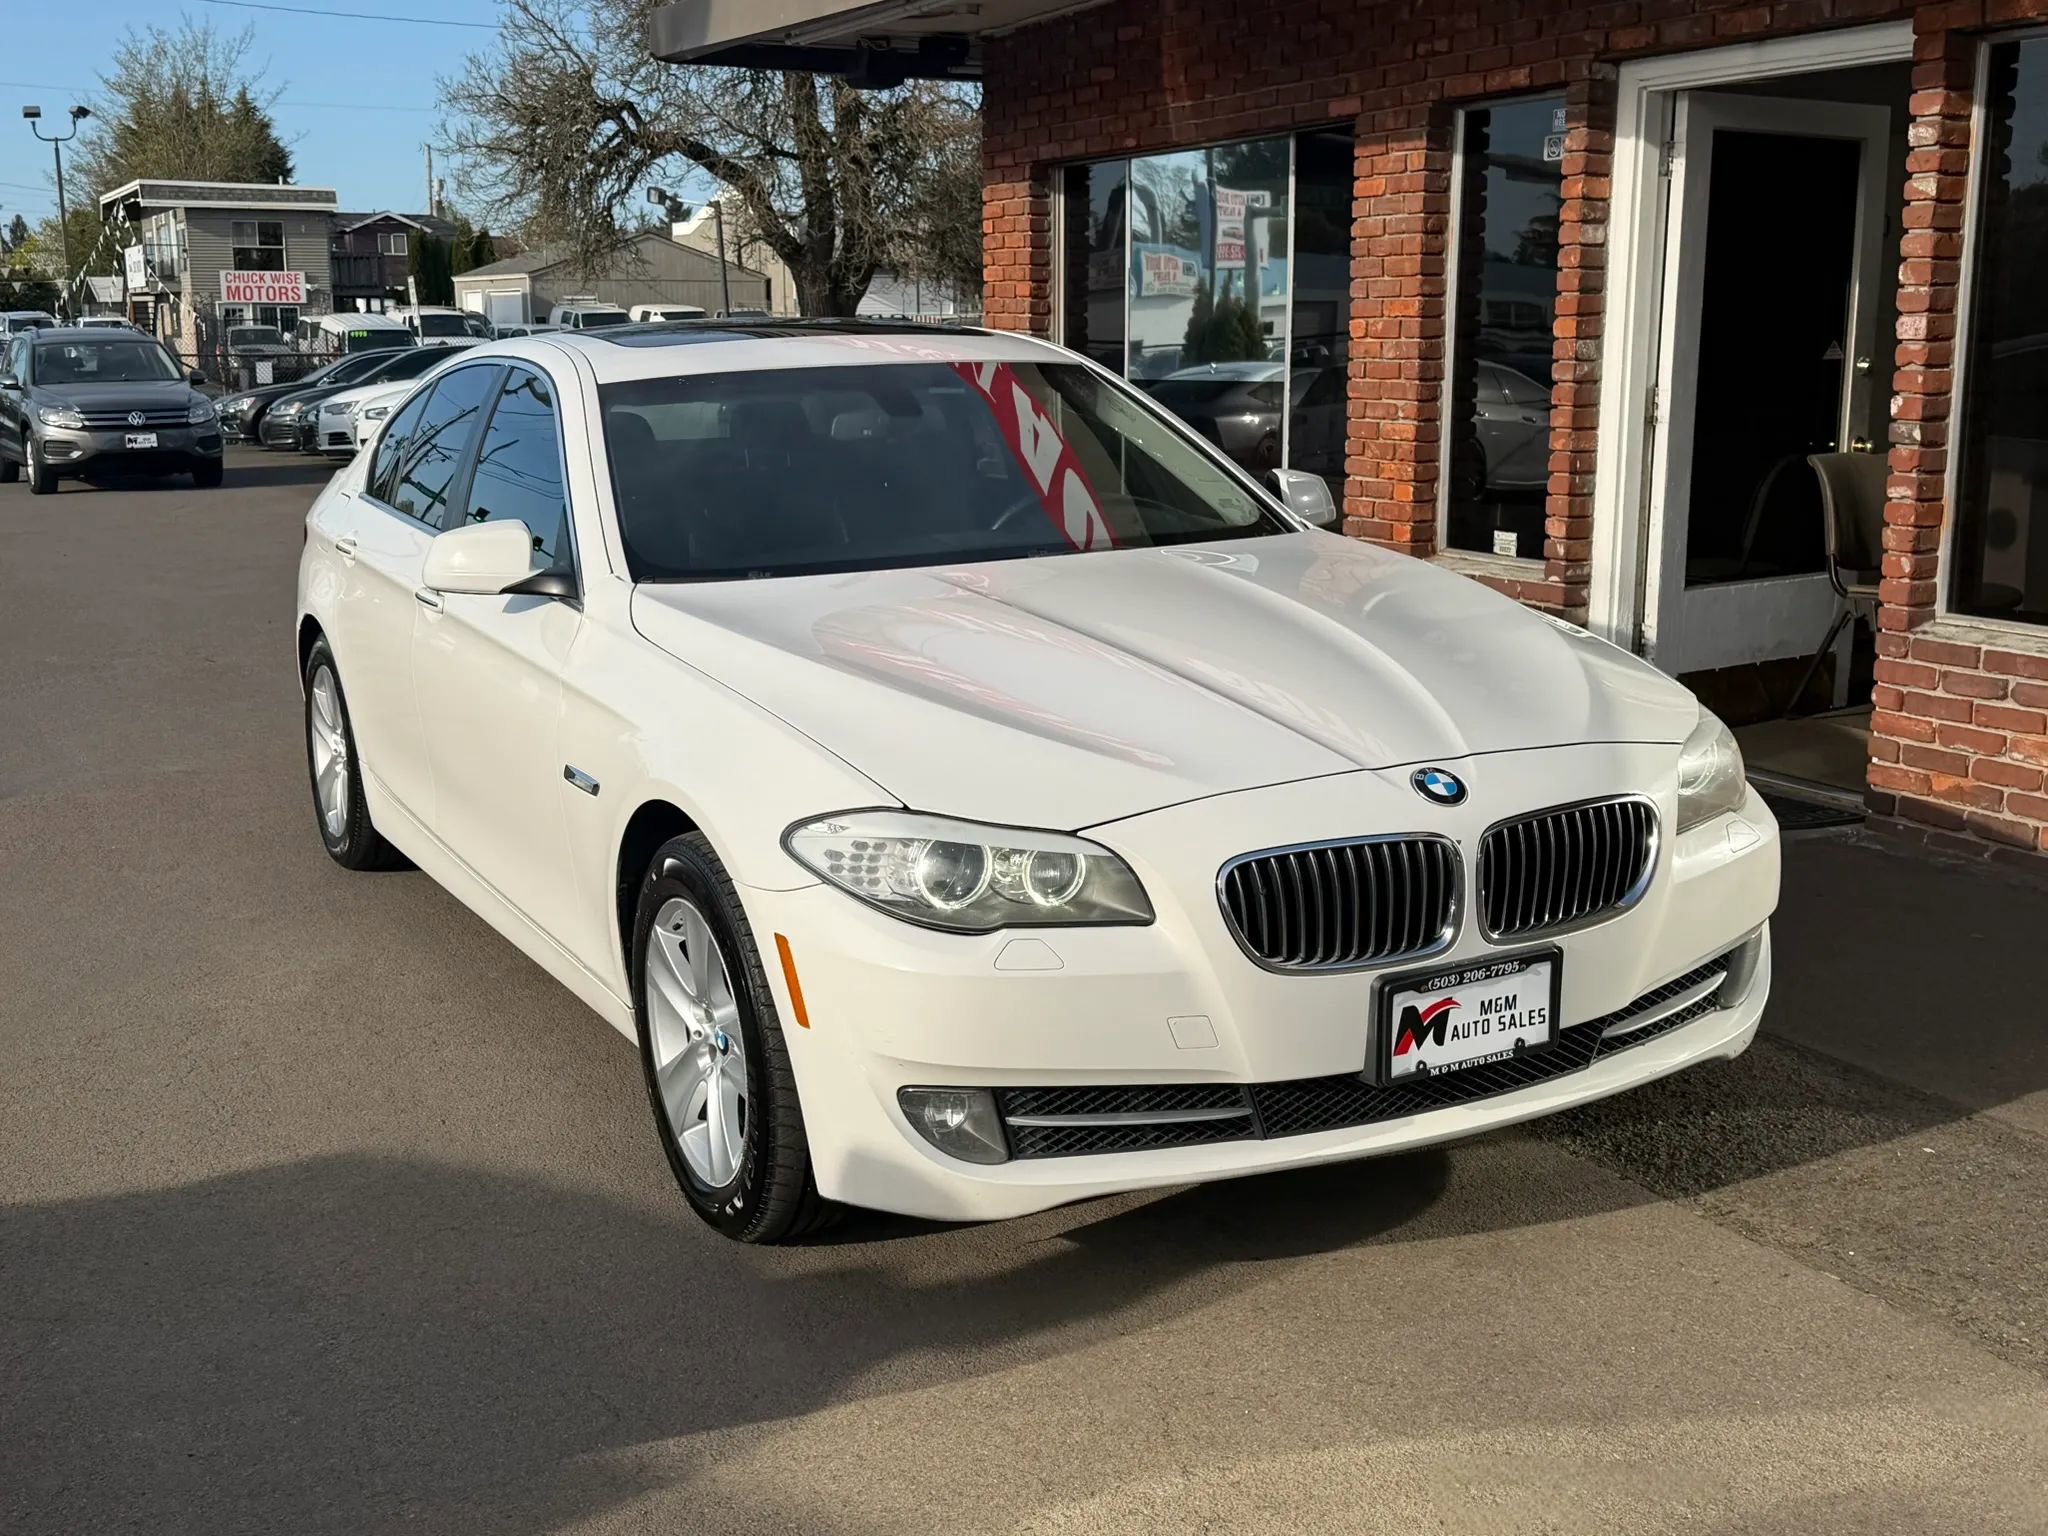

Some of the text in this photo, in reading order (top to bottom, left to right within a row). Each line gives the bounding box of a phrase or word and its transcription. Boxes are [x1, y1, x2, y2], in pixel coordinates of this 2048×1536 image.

[225, 272, 301, 285] CHUCK WISE
[226, 285, 301, 302] MOTORS
[1428, 961, 1520, 991] (503) 206-7795
[1480, 994, 1517, 1016] M&M
[1450, 1008, 1546, 1042] AUTO SALES
[1430, 1066, 1440, 1076] M
[1450, 1062, 1460, 1072] M
[1461, 1058, 1485, 1070] AUTO
[1486, 1050, 1514, 1063] SALES
